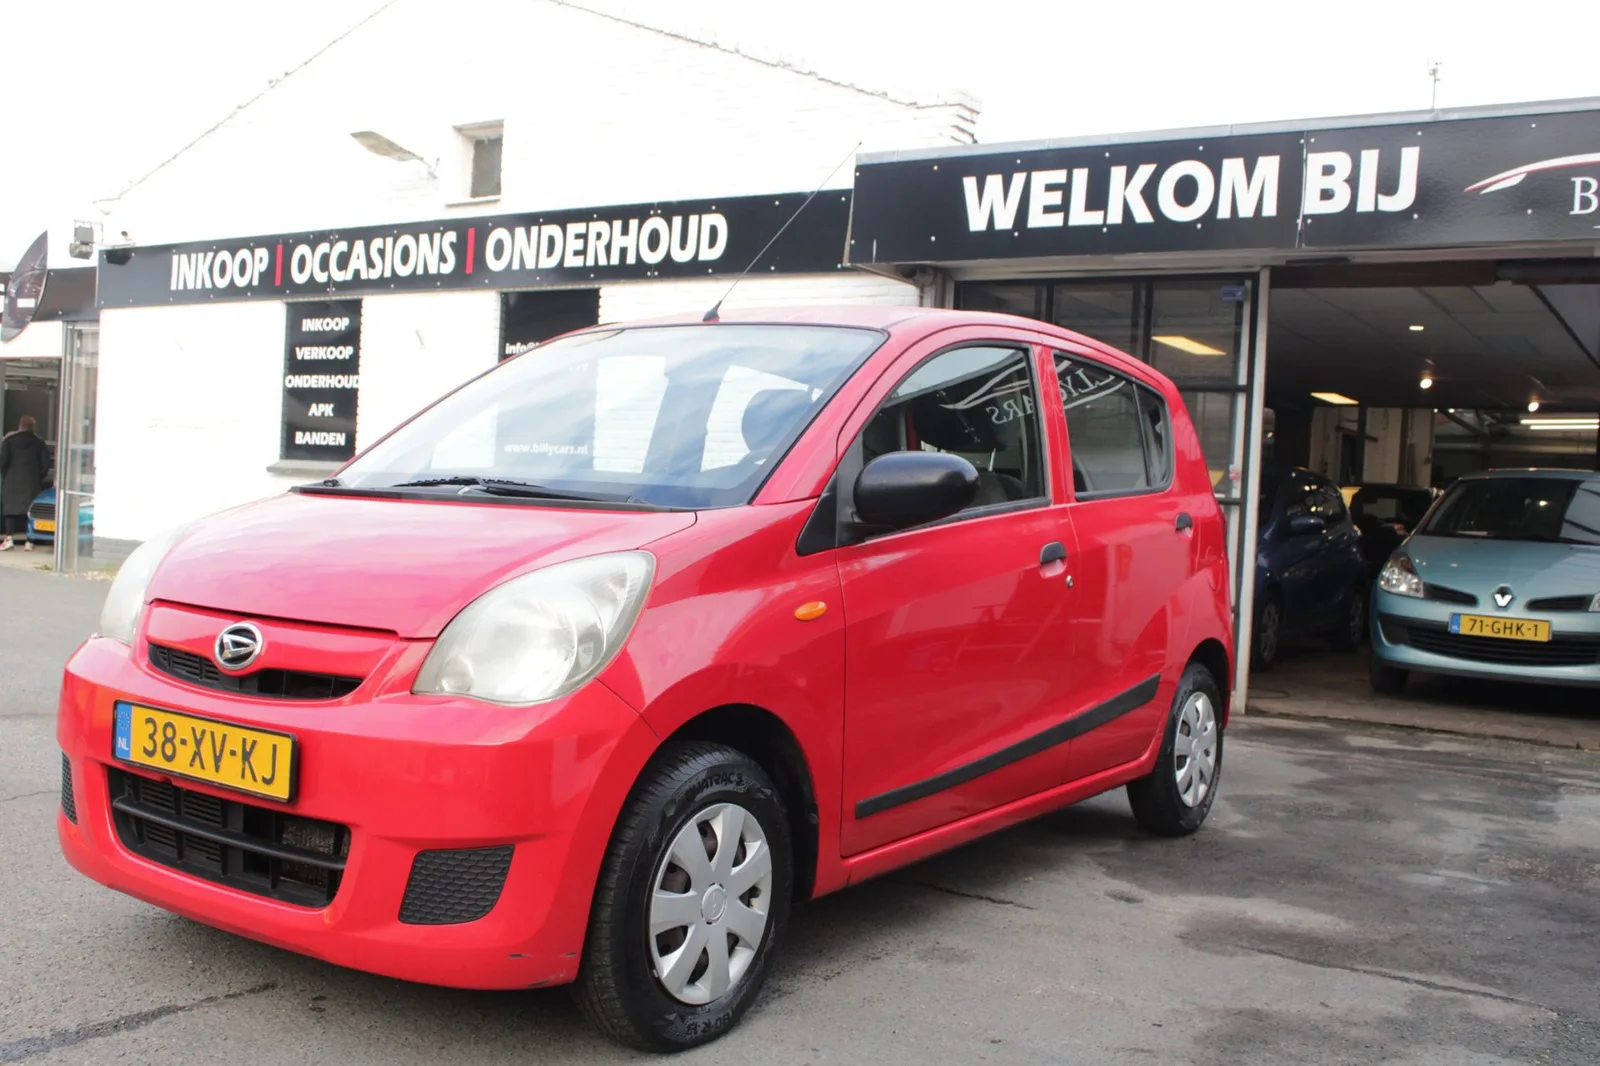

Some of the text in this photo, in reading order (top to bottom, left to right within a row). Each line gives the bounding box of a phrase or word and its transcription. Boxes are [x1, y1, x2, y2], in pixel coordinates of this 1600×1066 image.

[962, 146, 1421, 232] WELKOM BIJ
[170, 213, 728, 291] INKOOP OCCASIONS ONDERHOUD
[301, 317, 349, 332] INKOOP
[295, 346, 354, 360] VERKOOP
[308, 403, 334, 417] APK
[295, 431, 346, 446] BANDEN
[503, 442, 588, 456] www.billycars.nl
[1469, 618, 1539, 637] 71-GHK-1
[118, 736, 129, 750] NL
[142, 716, 278, 786] 38-XV-KJ
